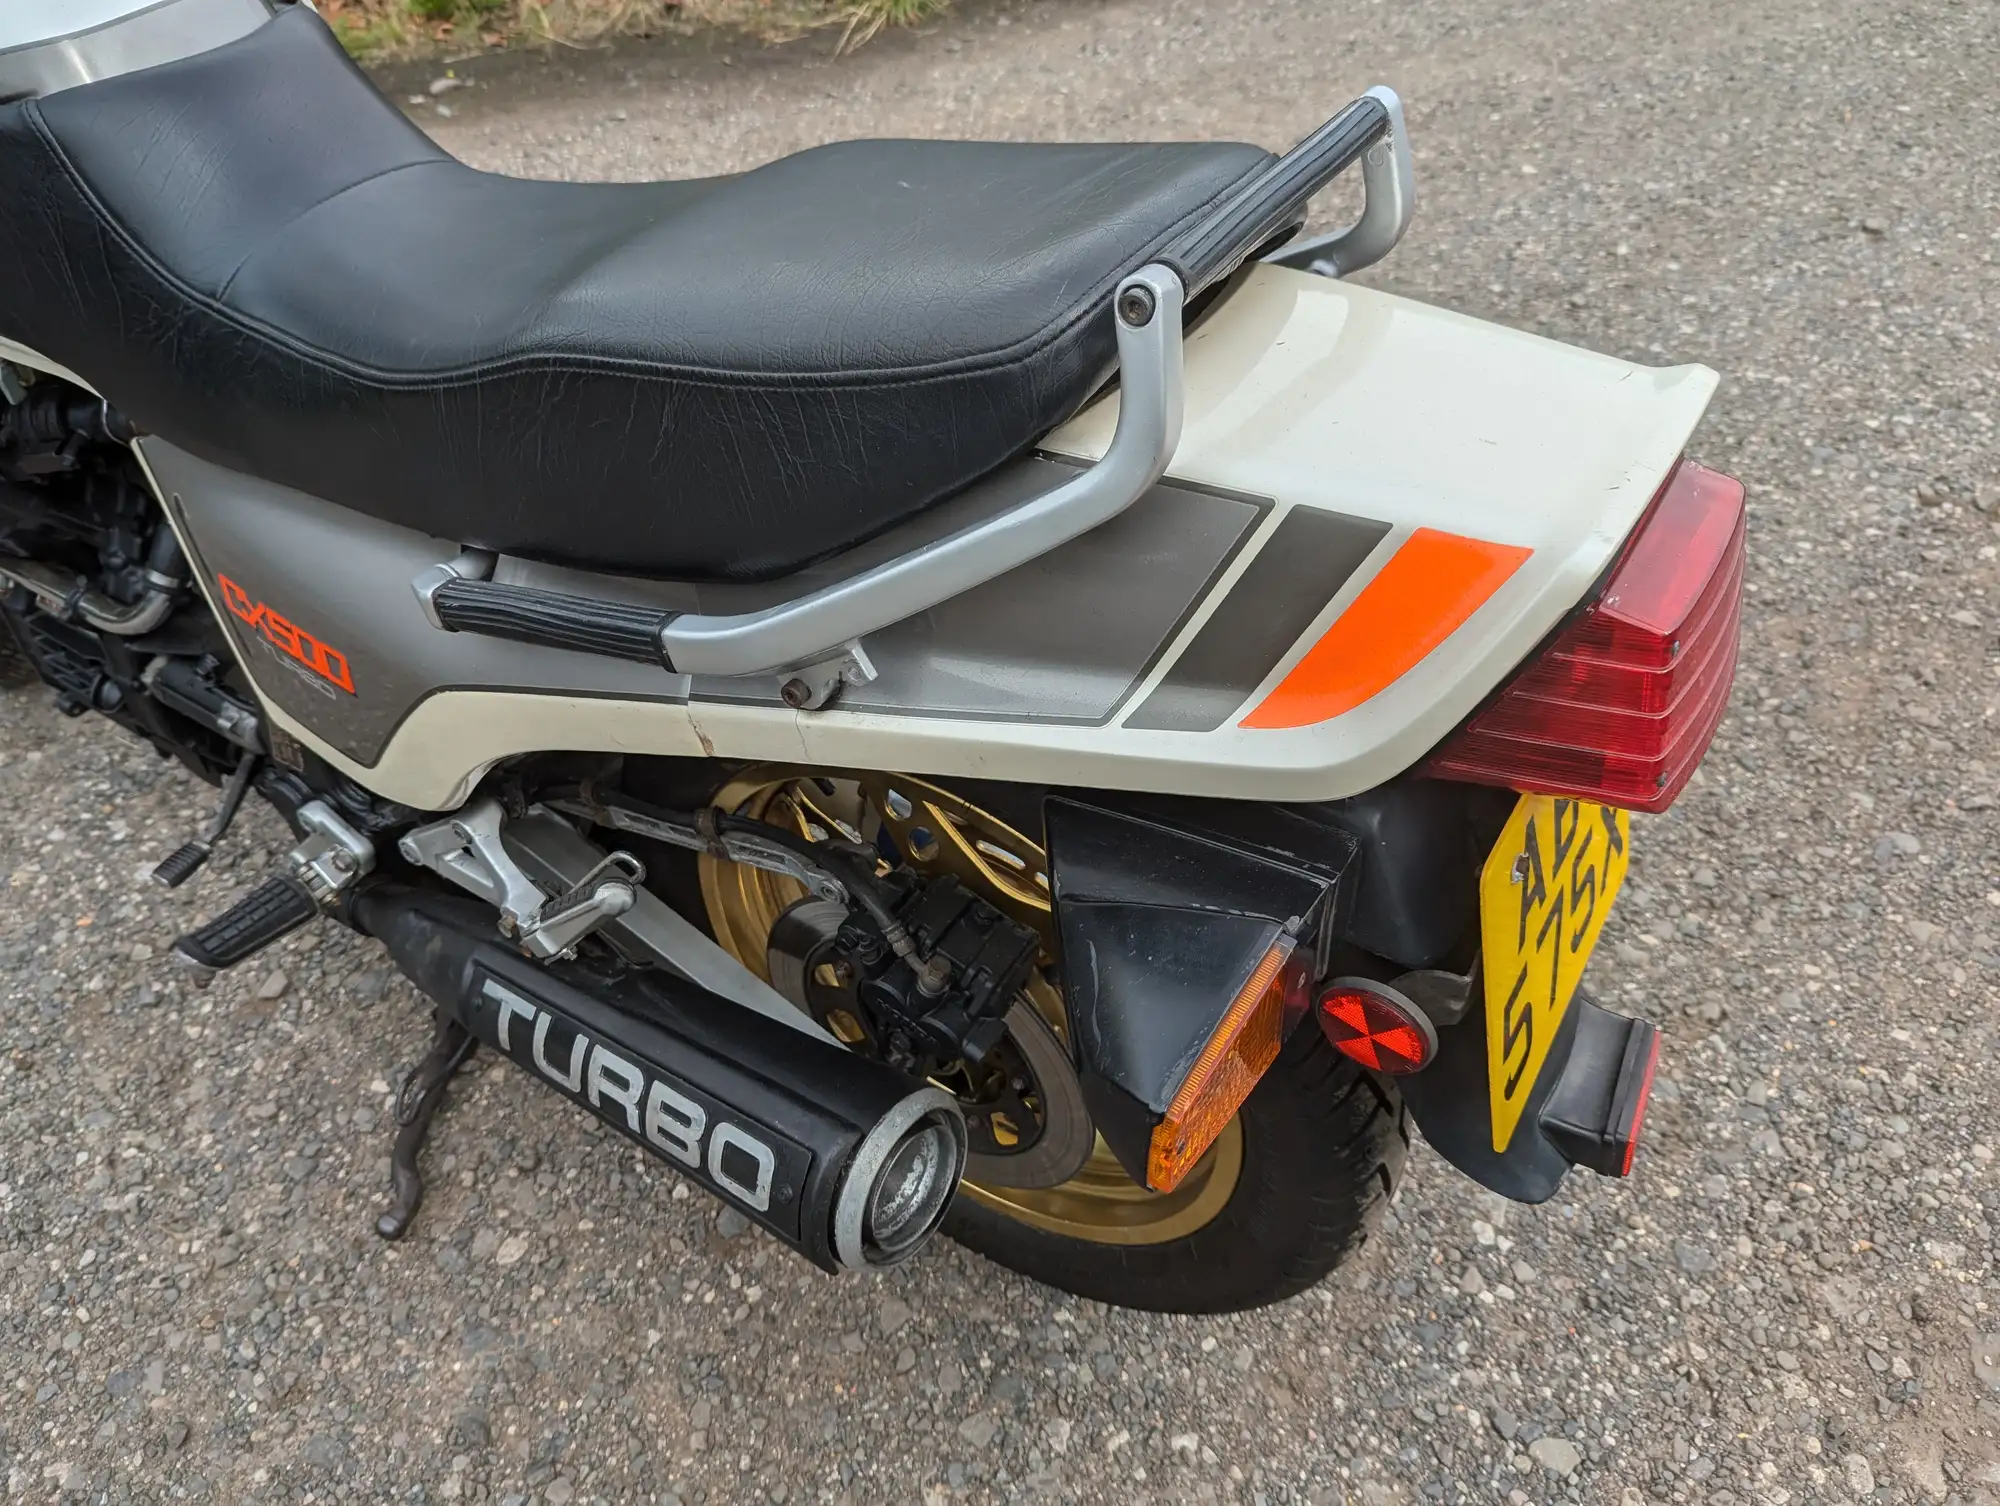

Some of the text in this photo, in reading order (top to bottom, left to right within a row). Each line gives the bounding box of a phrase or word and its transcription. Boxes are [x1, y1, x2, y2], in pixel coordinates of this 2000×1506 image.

[217, 573, 356, 695] CX500
[256, 635, 337, 700] TURBO
[1502, 806, 1624, 1101] 575X
[482, 978, 775, 1212] TURBO
